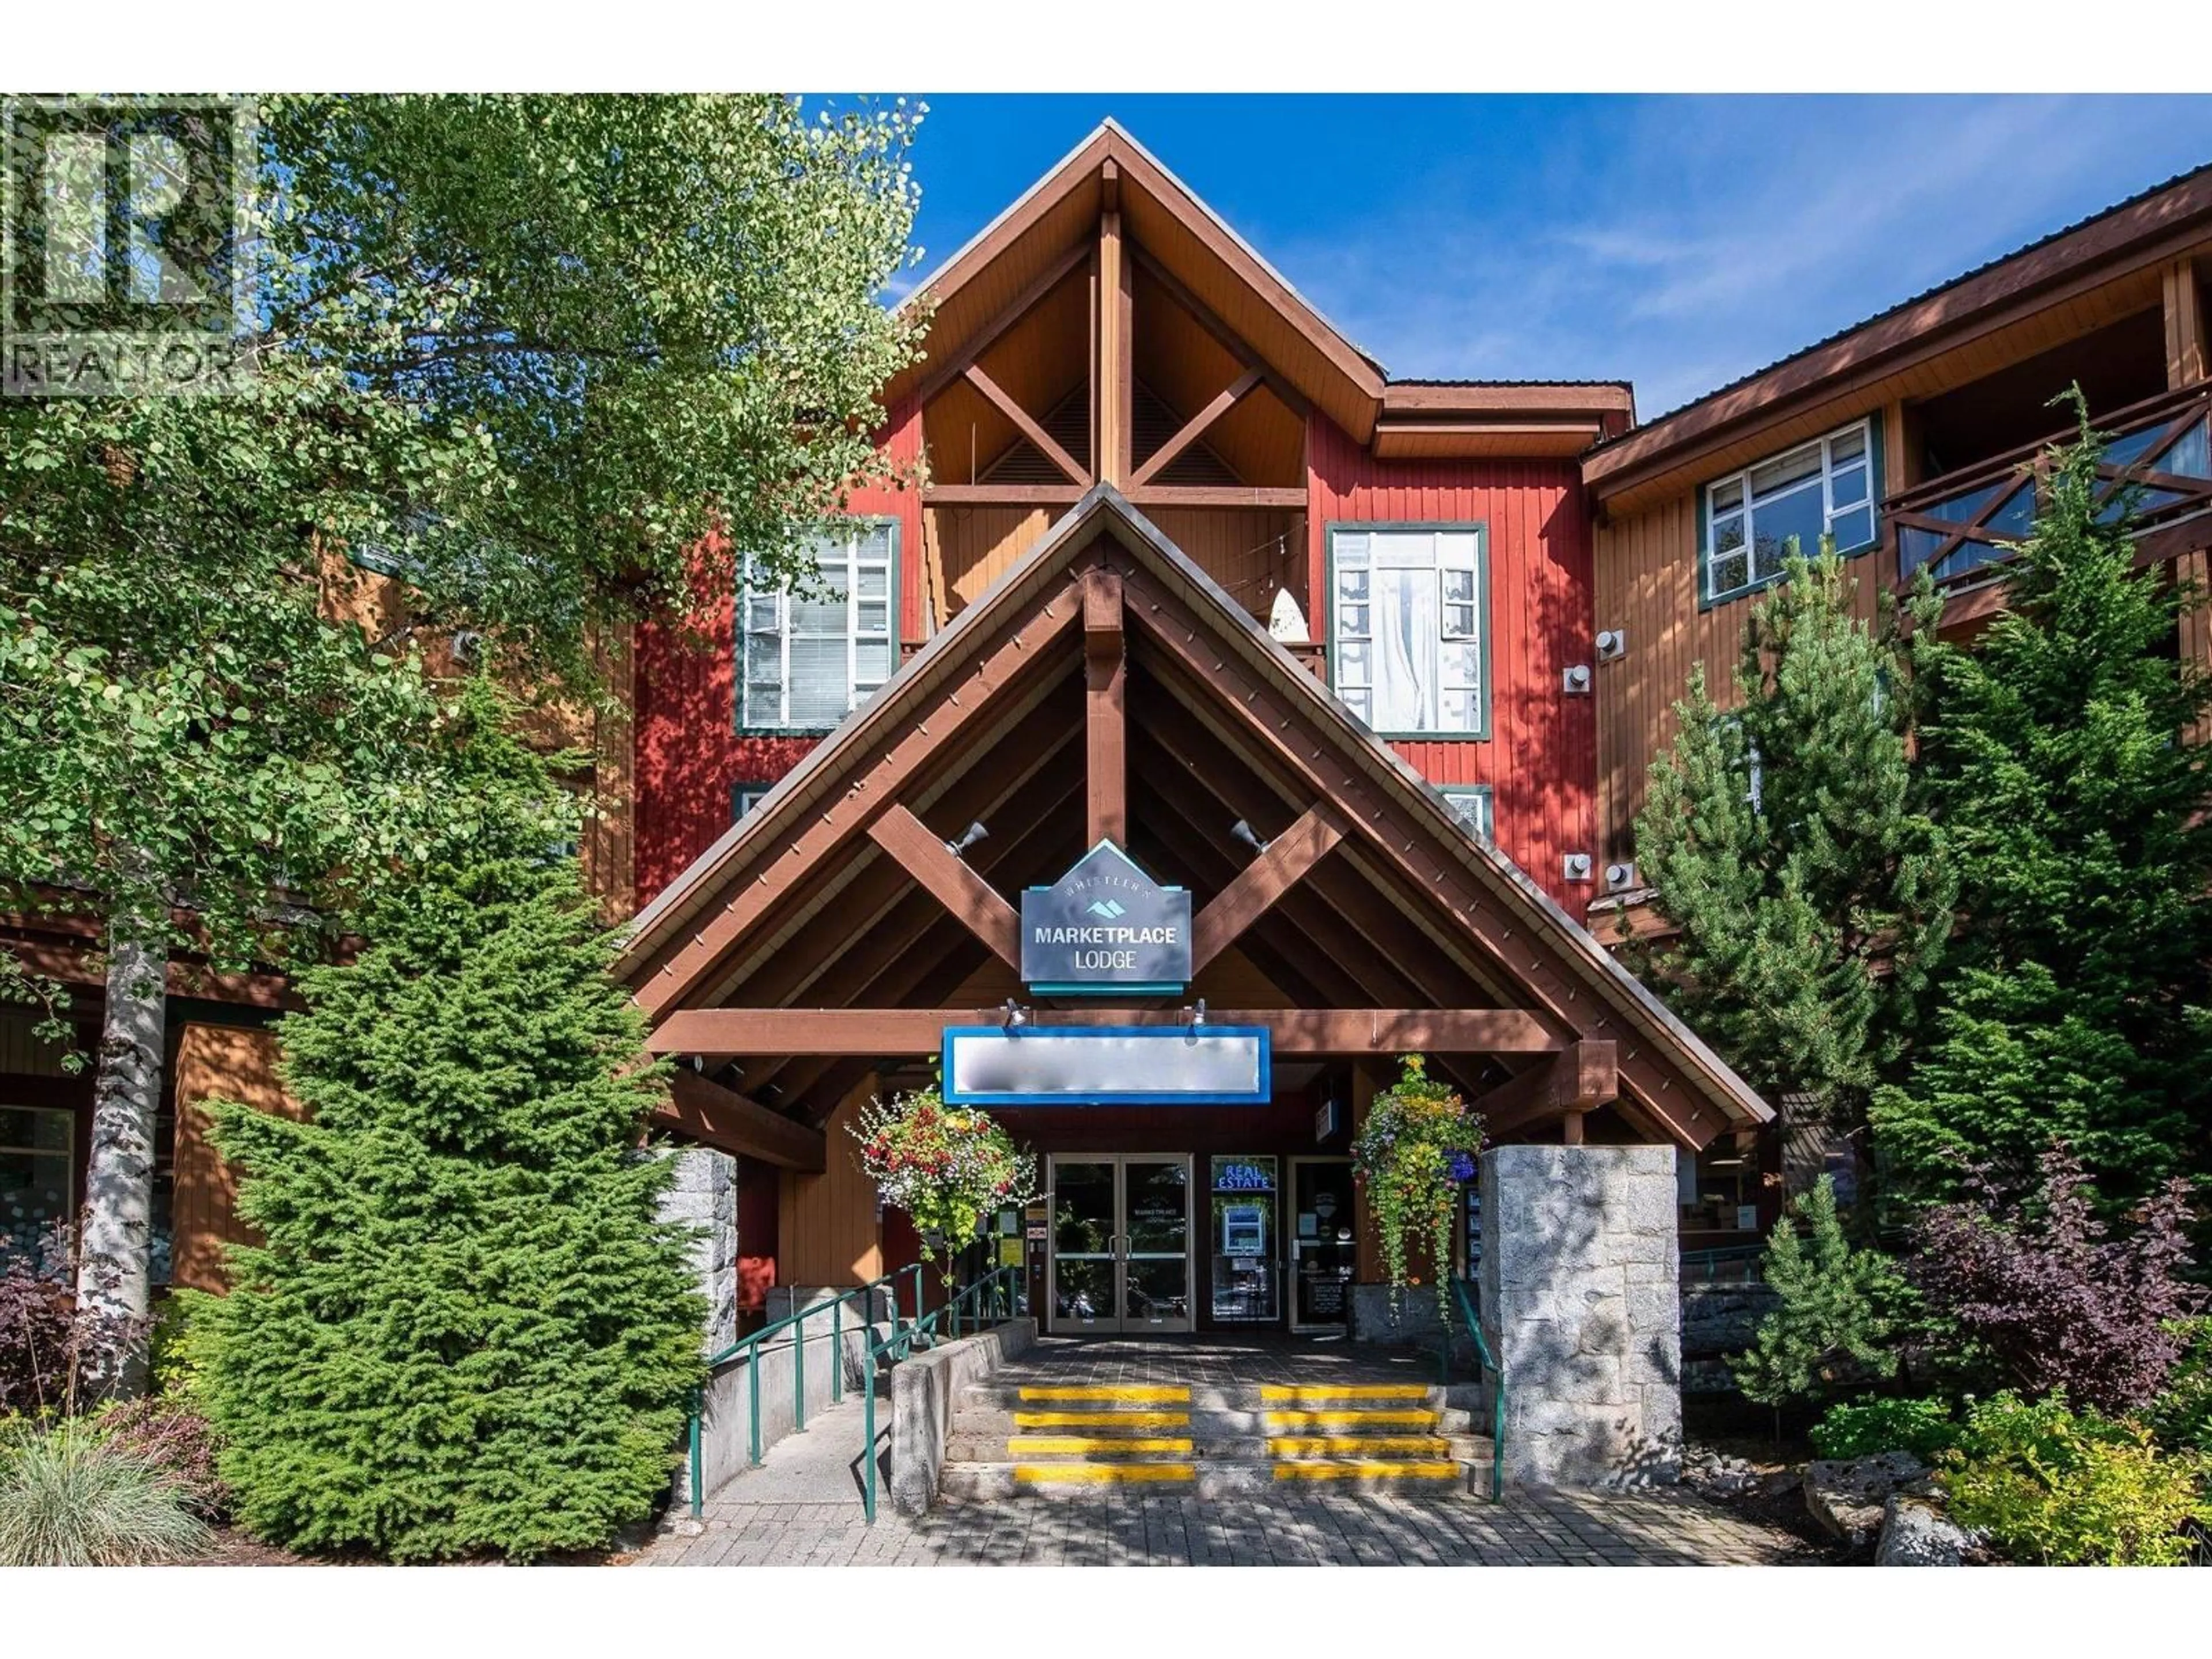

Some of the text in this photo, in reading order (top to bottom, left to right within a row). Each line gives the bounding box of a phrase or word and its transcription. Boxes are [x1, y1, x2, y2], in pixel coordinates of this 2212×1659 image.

[1035, 927, 1177, 944] MARKETPLACE
[1075, 950, 1137, 969] LODGE
[1226, 1165, 1262, 1178] REAL
[1219, 1177, 1270, 1189] ESTATE
